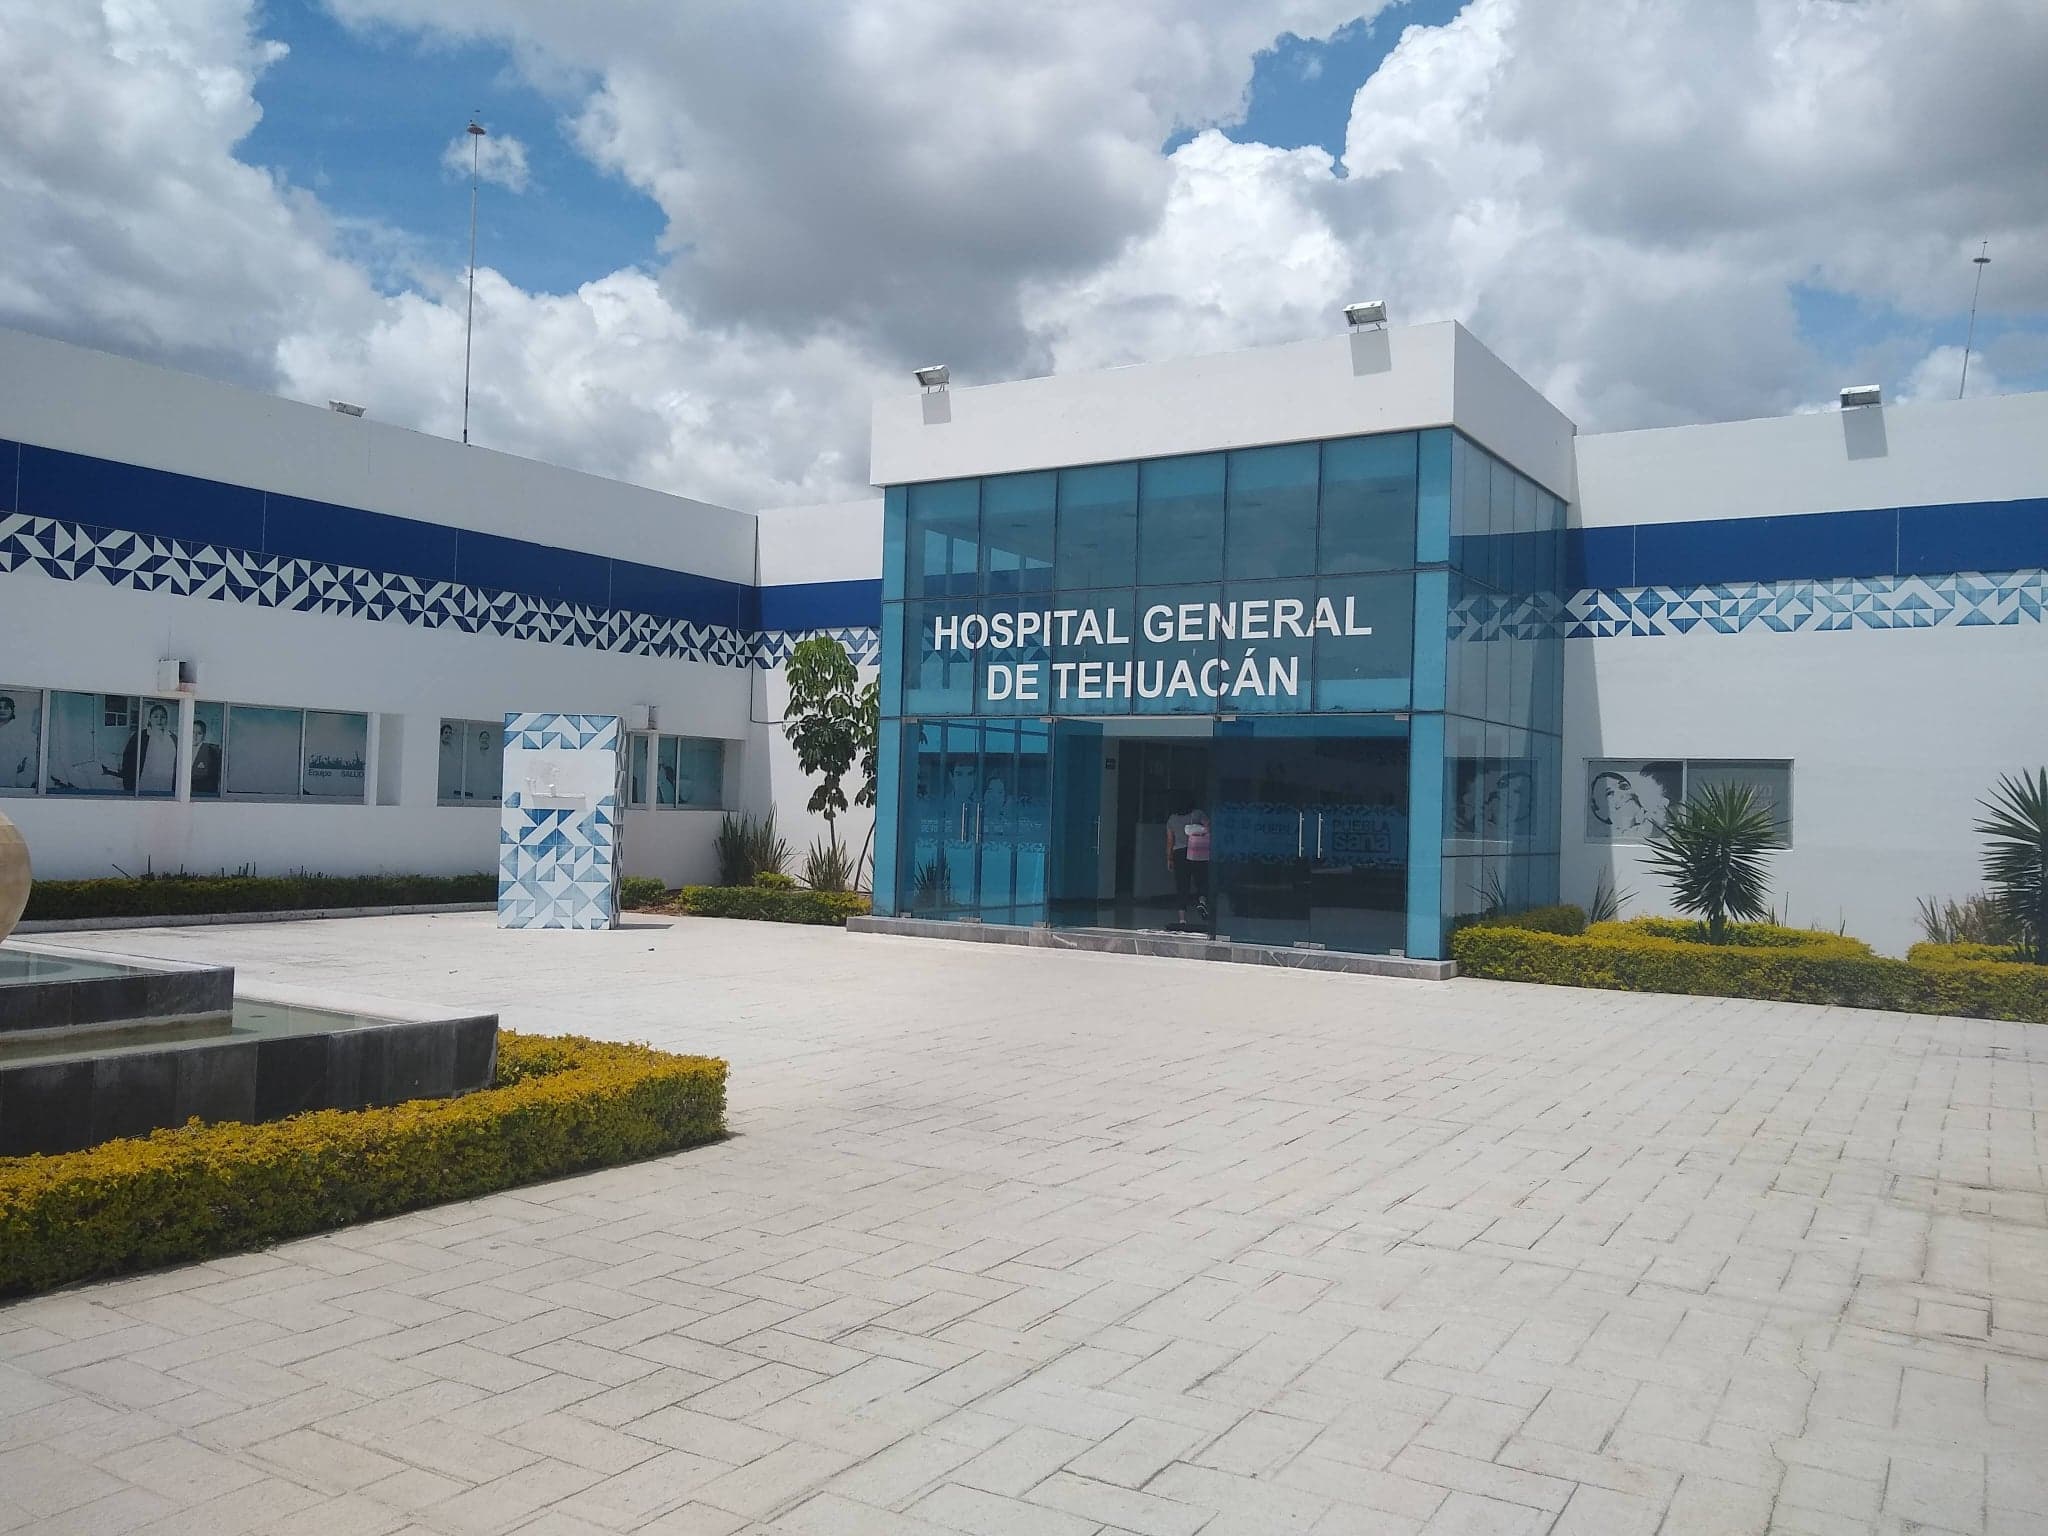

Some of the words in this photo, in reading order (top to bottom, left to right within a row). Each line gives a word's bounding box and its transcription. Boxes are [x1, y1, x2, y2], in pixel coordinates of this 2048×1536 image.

[934, 607, 1129, 651] HOSPITAL
[1143, 596, 1373, 644] GENERAL
[987, 663, 1039, 701] DE
[1052, 647, 1298, 699] TEHUACÁN
[1332, 819, 1390, 832] PUEBLA
